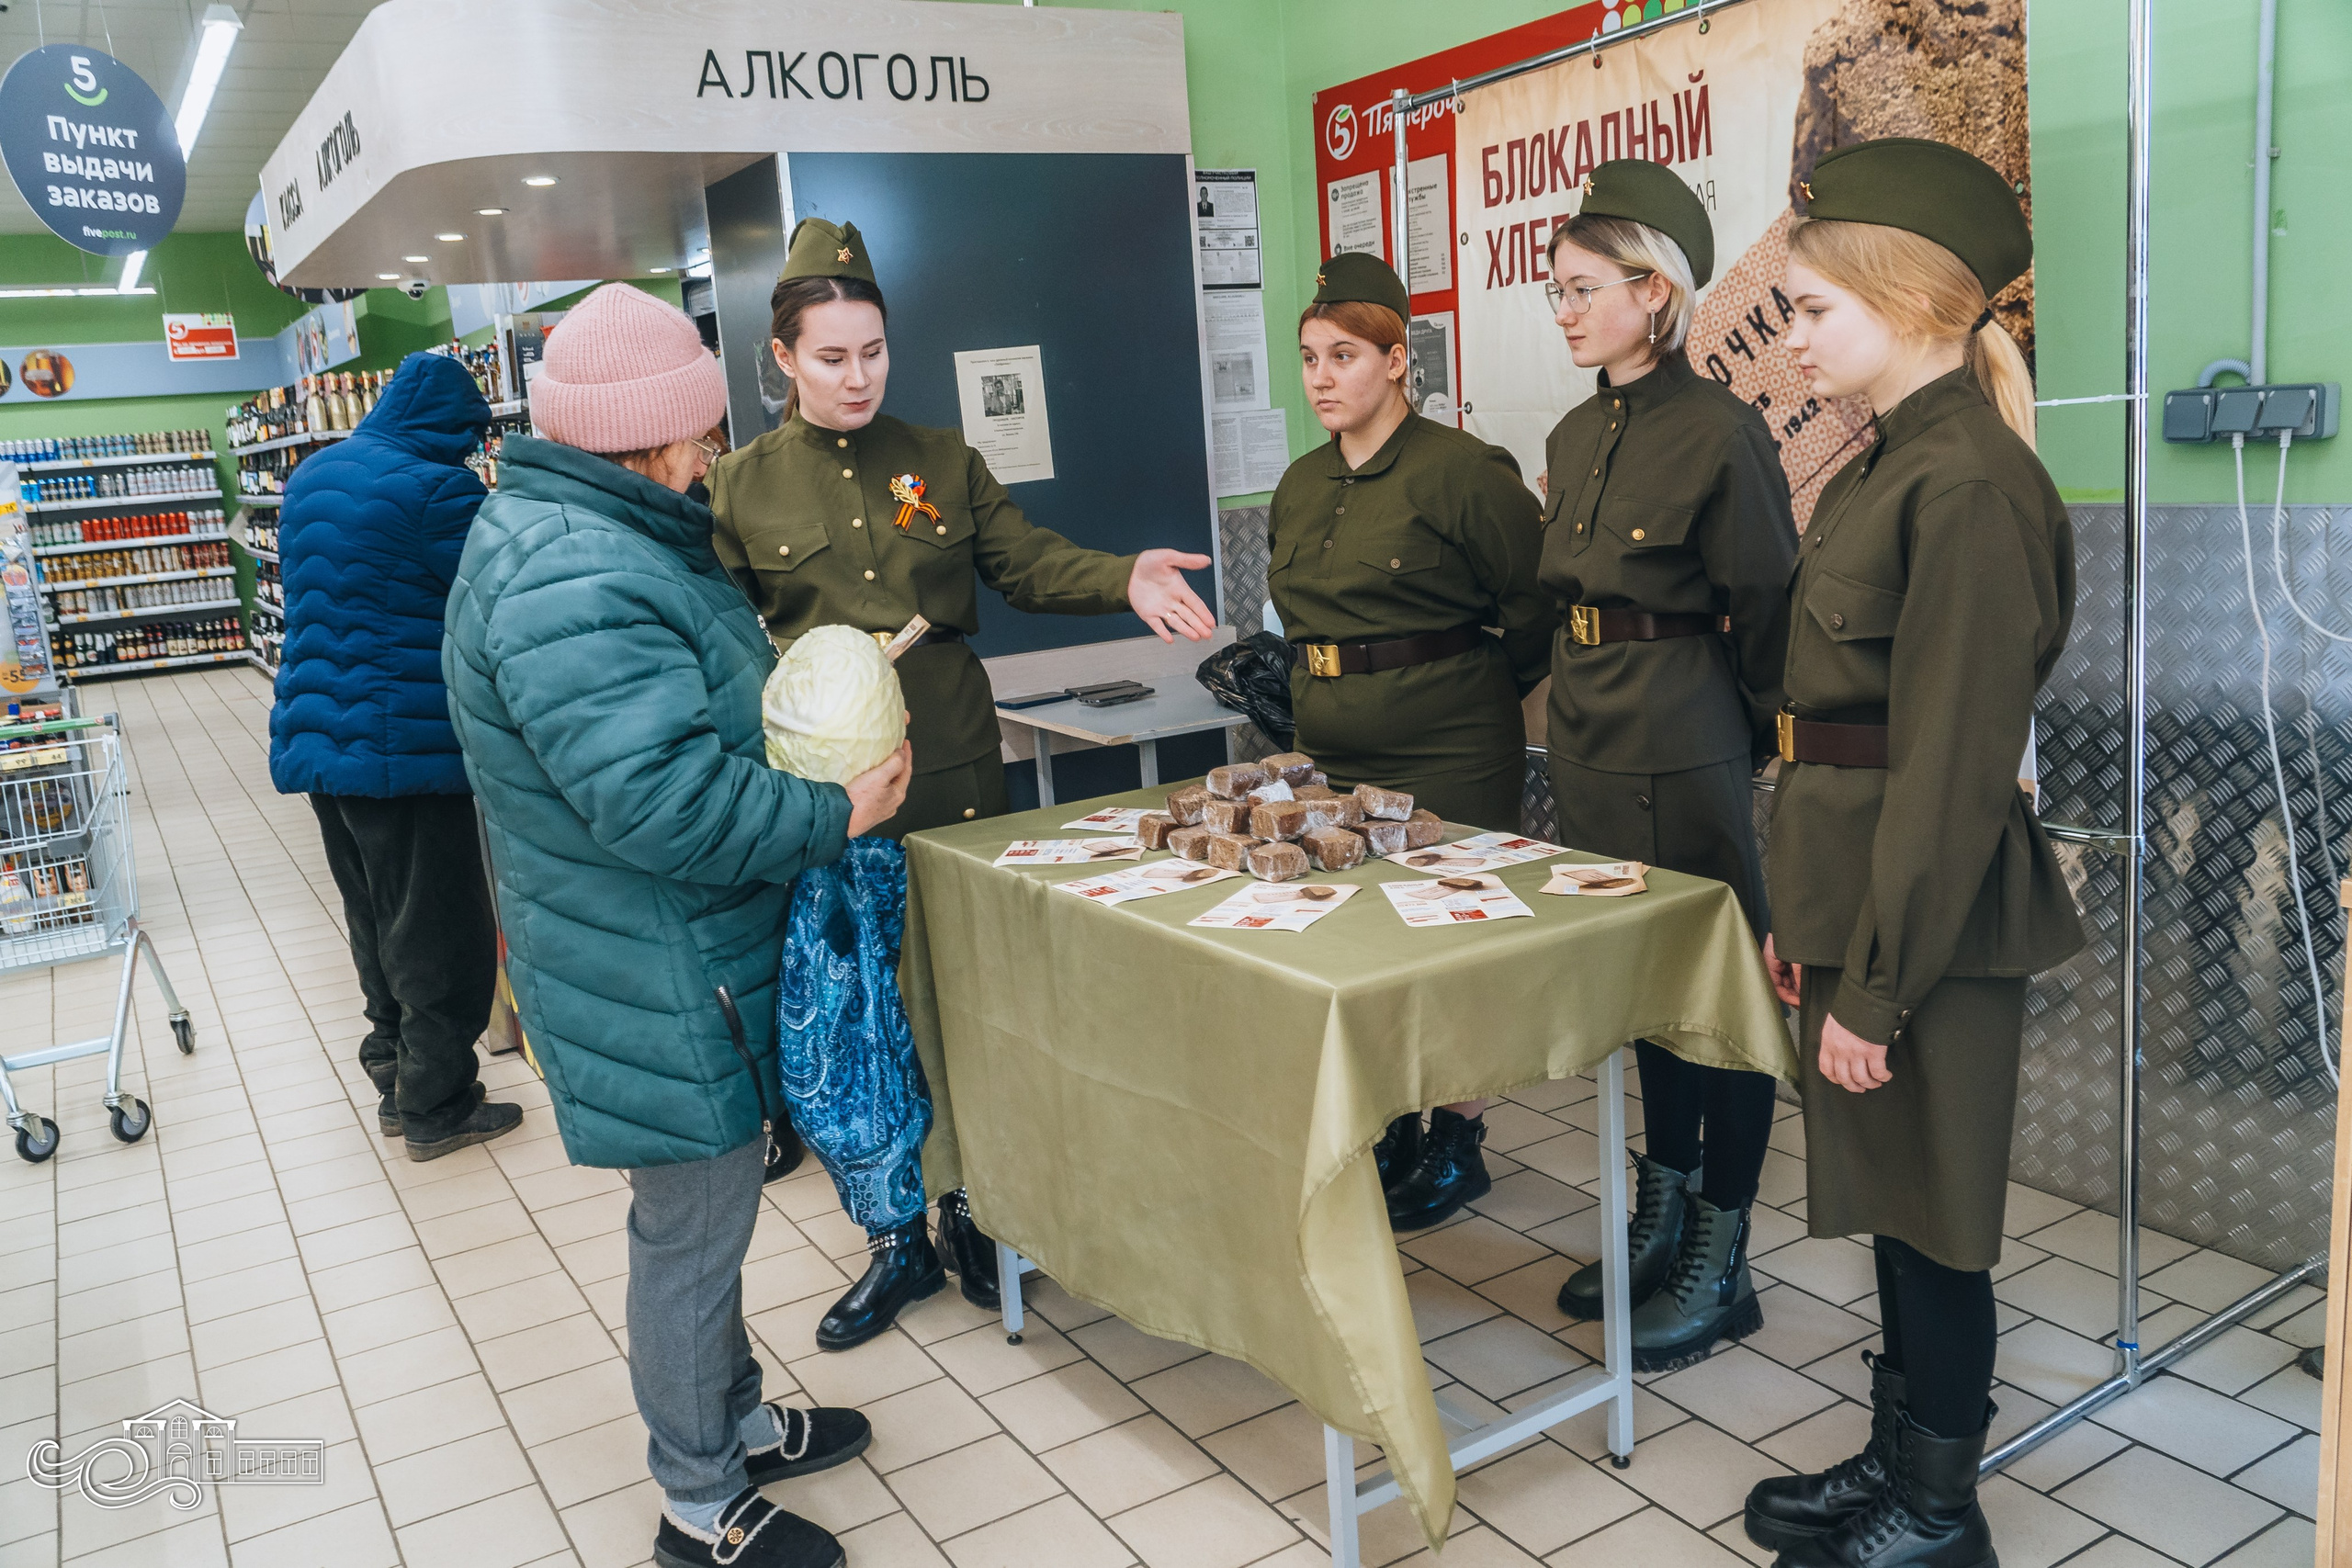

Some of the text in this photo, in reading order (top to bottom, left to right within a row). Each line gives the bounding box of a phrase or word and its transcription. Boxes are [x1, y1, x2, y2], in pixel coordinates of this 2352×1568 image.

[696, 49, 990, 103] АЛКОГОЛЬ
[46, 114, 139, 150] Пункт
[316, 109, 361, 193] АЛКОГОЛЬ
[1481, 69, 1713, 209] БЛОКАДНЫЙ
[42, 152, 155, 183] выдачи
[1408, 183, 1438, 195] кстренные
[46, 184, 162, 215] заказов
[278, 177, 305, 231] КАССА
[82, 225, 137, 240] fivepost.ru
[1485, 212, 1571, 291] ХЛЕ
[1782, 397, 1822, 440] 1942
